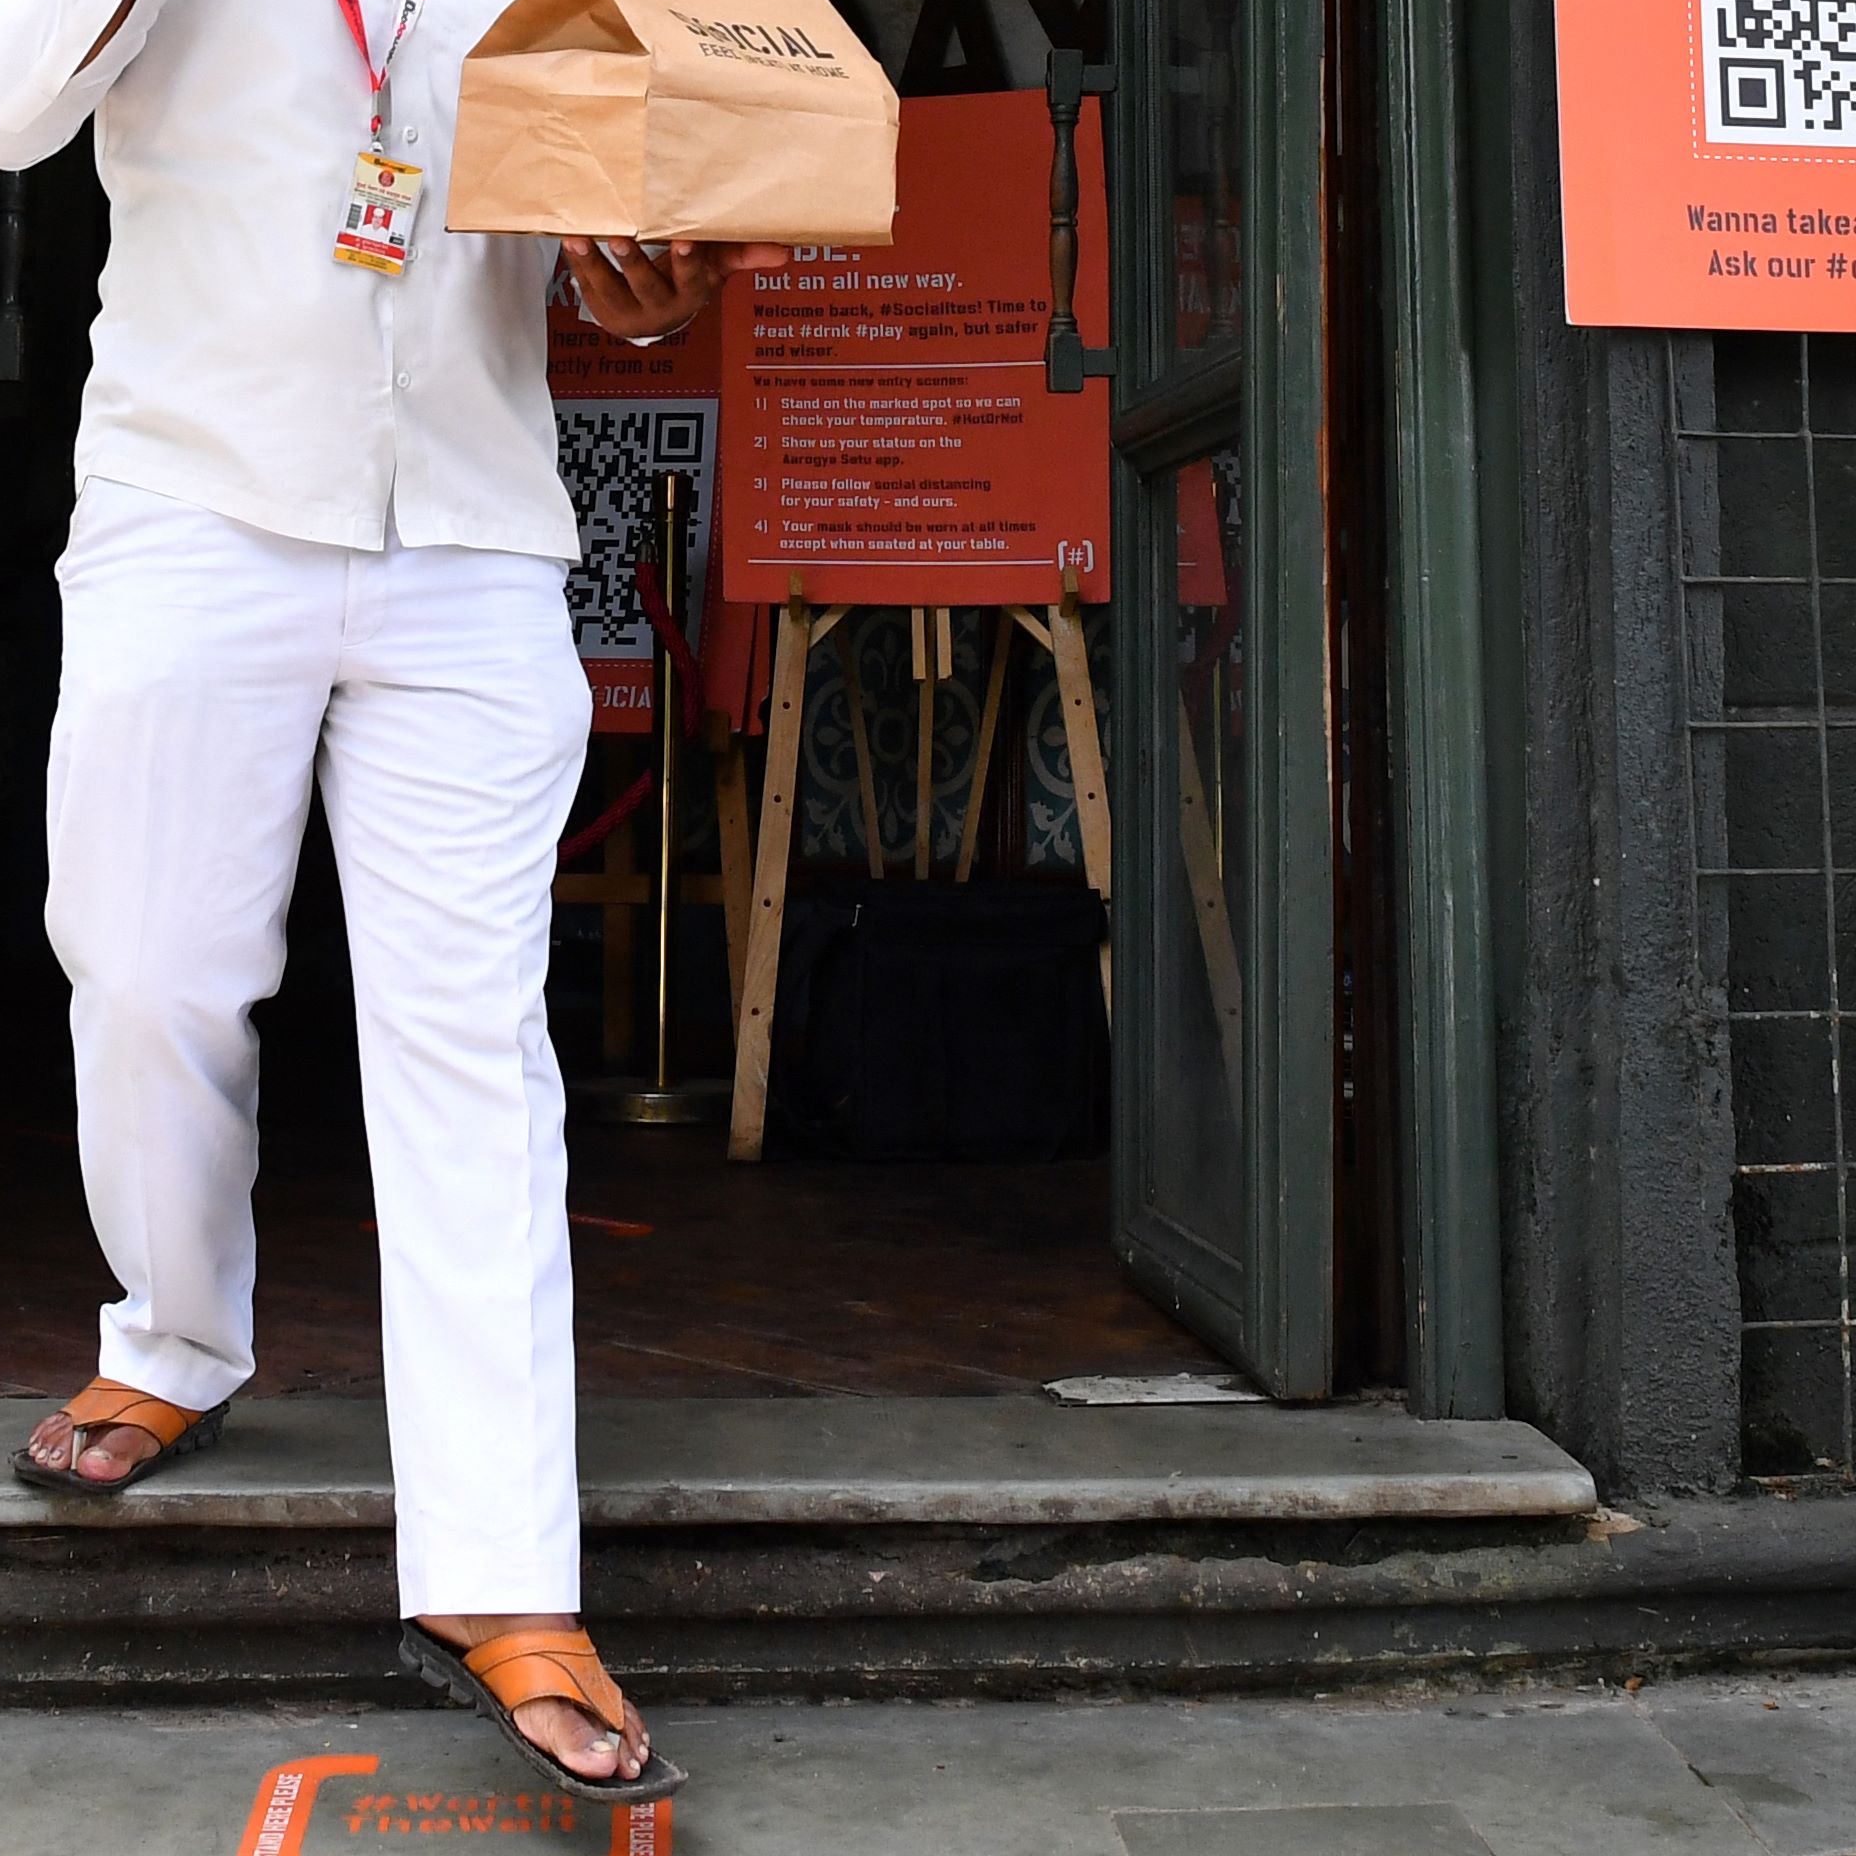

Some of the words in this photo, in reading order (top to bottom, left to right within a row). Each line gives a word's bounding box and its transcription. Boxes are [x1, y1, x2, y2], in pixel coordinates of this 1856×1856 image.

[1687, 205, 1778, 234] Wanna
[1708, 250, 1758, 278] Ask
[1767, 255, 1815, 279] our
[754, 272, 791, 291] but
[798, 275, 825, 290] an
[832, 272, 859, 290] all
[866, 273, 909, 289] new
[916, 273, 963, 292] way.
[753, 324, 794, 338] #eat
[799, 324, 850, 338] #drnk
[856, 323, 904, 341] #play
[908, 323, 959, 339] again,
[964, 322, 990, 335] but
[995, 321, 1038, 334] safer
[755, 344, 785, 357] and
[790, 344, 838, 358] wiser.
[781, 397, 820, 410] Stand
[824, 400, 840, 410] on
[844, 397, 865, 409] the
[870, 397, 919, 409] marked
[922, 397, 952, 411] spot
[956, 399, 971, 408] so
[975, 398, 992, 407] we
[996, 396, 1021, 407] can
[781, 436, 816, 448] Show
[820, 439, 836, 448] us
[840, 439, 869, 451] your
[873, 436, 915, 448] status
[919, 438, 936, 448] on
[940, 436, 962, 447] the
[780, 495, 800, 507] for
[804, 497, 834, 509] your
[837, 495, 880, 510] safety
[894, 495, 919, 507] and
[922, 497, 958, 507] ours.
